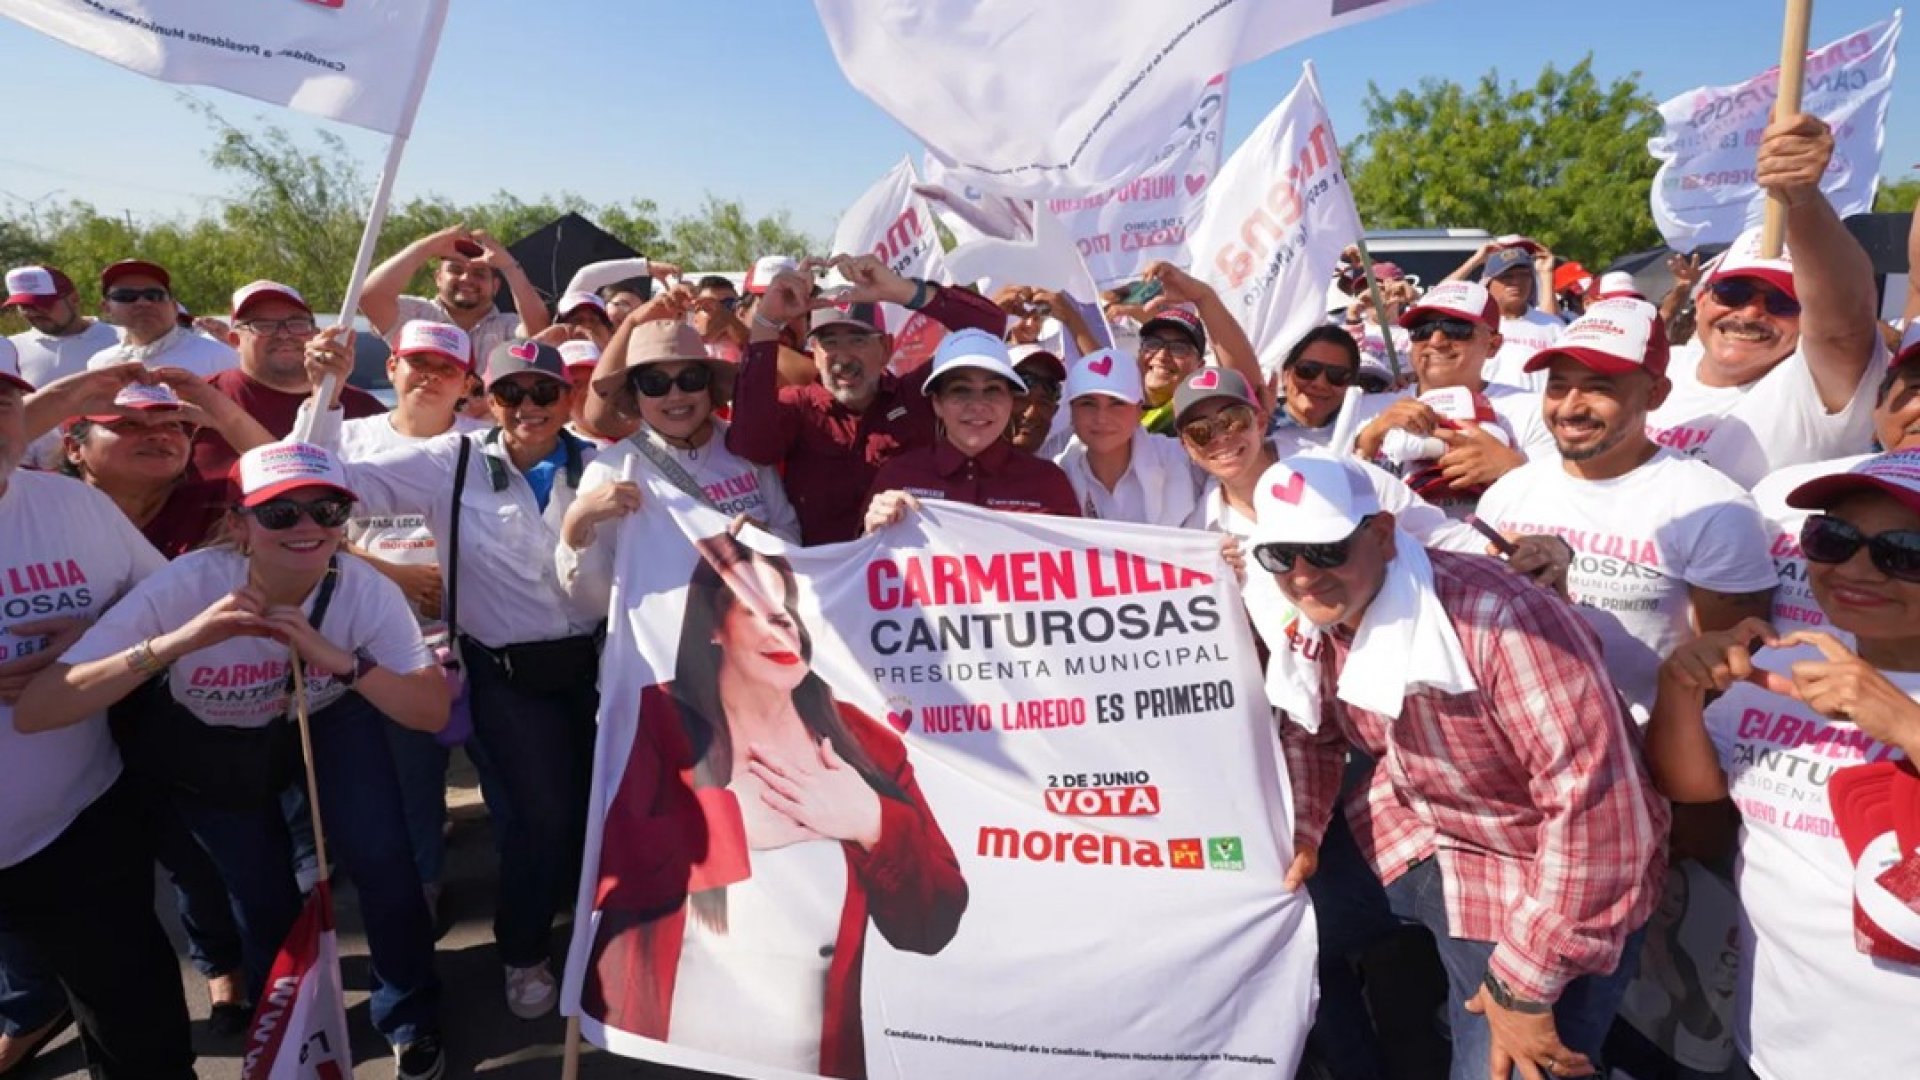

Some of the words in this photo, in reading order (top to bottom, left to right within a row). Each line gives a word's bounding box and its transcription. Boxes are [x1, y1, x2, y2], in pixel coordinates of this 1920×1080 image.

[1590, 533, 1660, 567] LILIA
[7, 558, 88, 595] LILIA
[866, 549, 1078, 612] CARMEN
[1087, 548, 1214, 598] LILIA
[869, 595, 1221, 656] CANTUROSAS
[874, 660, 1051, 684] PRESIDENTA
[1065, 644, 1229, 677] MUNICIPAL
[922, 703, 993, 734] NUEVO
[1002, 698, 1087, 731] LAREDO
[1098, 693, 1125, 724] ES
[1135, 679, 1236, 720] PRIMERO
[1047, 775, 1058, 788] 2
[1063, 774, 1088, 788] DE
[1092, 770, 1150, 786] JUNIO
[1048, 788, 1156, 814] VOTA
[977, 825, 1164, 867] morena
[1174, 850, 1199, 866] PT
